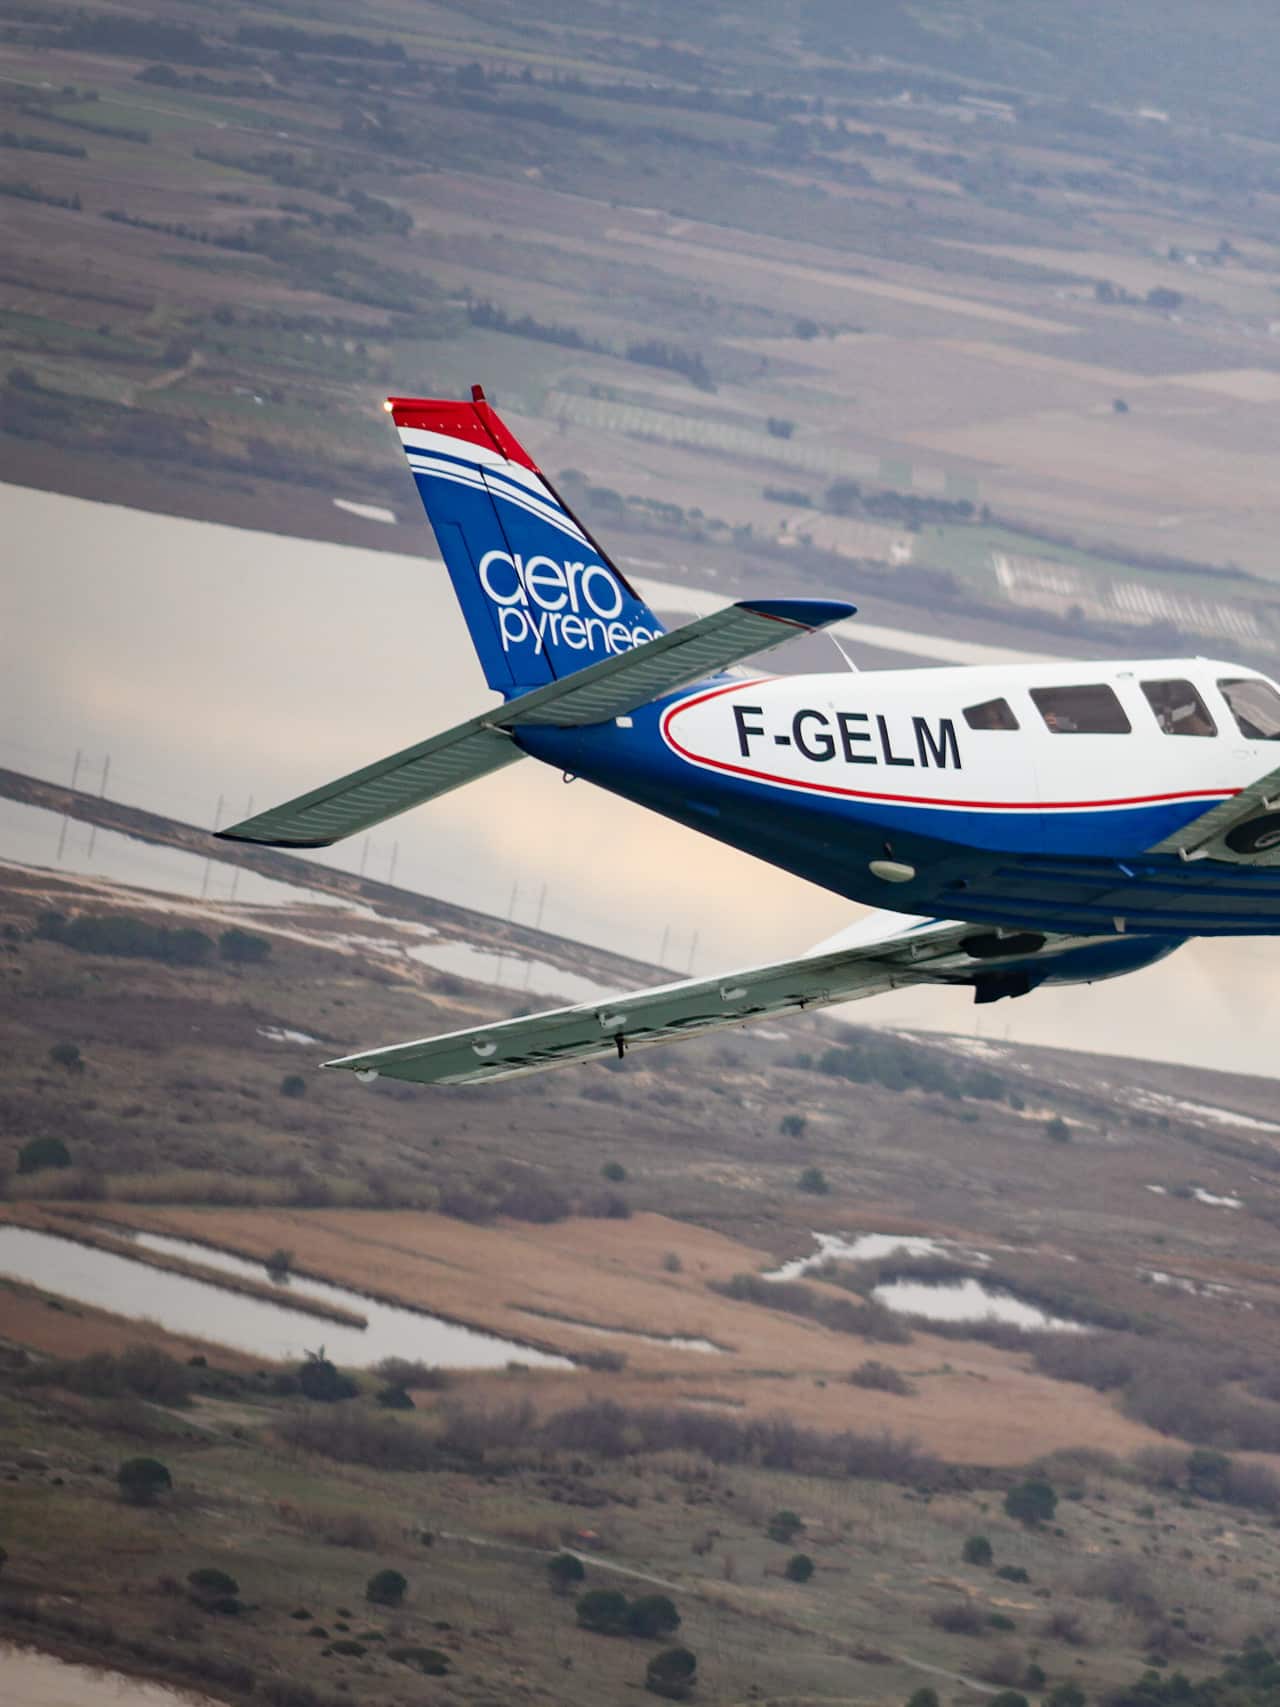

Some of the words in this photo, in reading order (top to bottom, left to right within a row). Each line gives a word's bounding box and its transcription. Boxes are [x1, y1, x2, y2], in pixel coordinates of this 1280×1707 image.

[479, 550, 623, 619] aero
[498, 607, 664, 655] pyrenee
[732, 705, 962, 769] F-GELM
